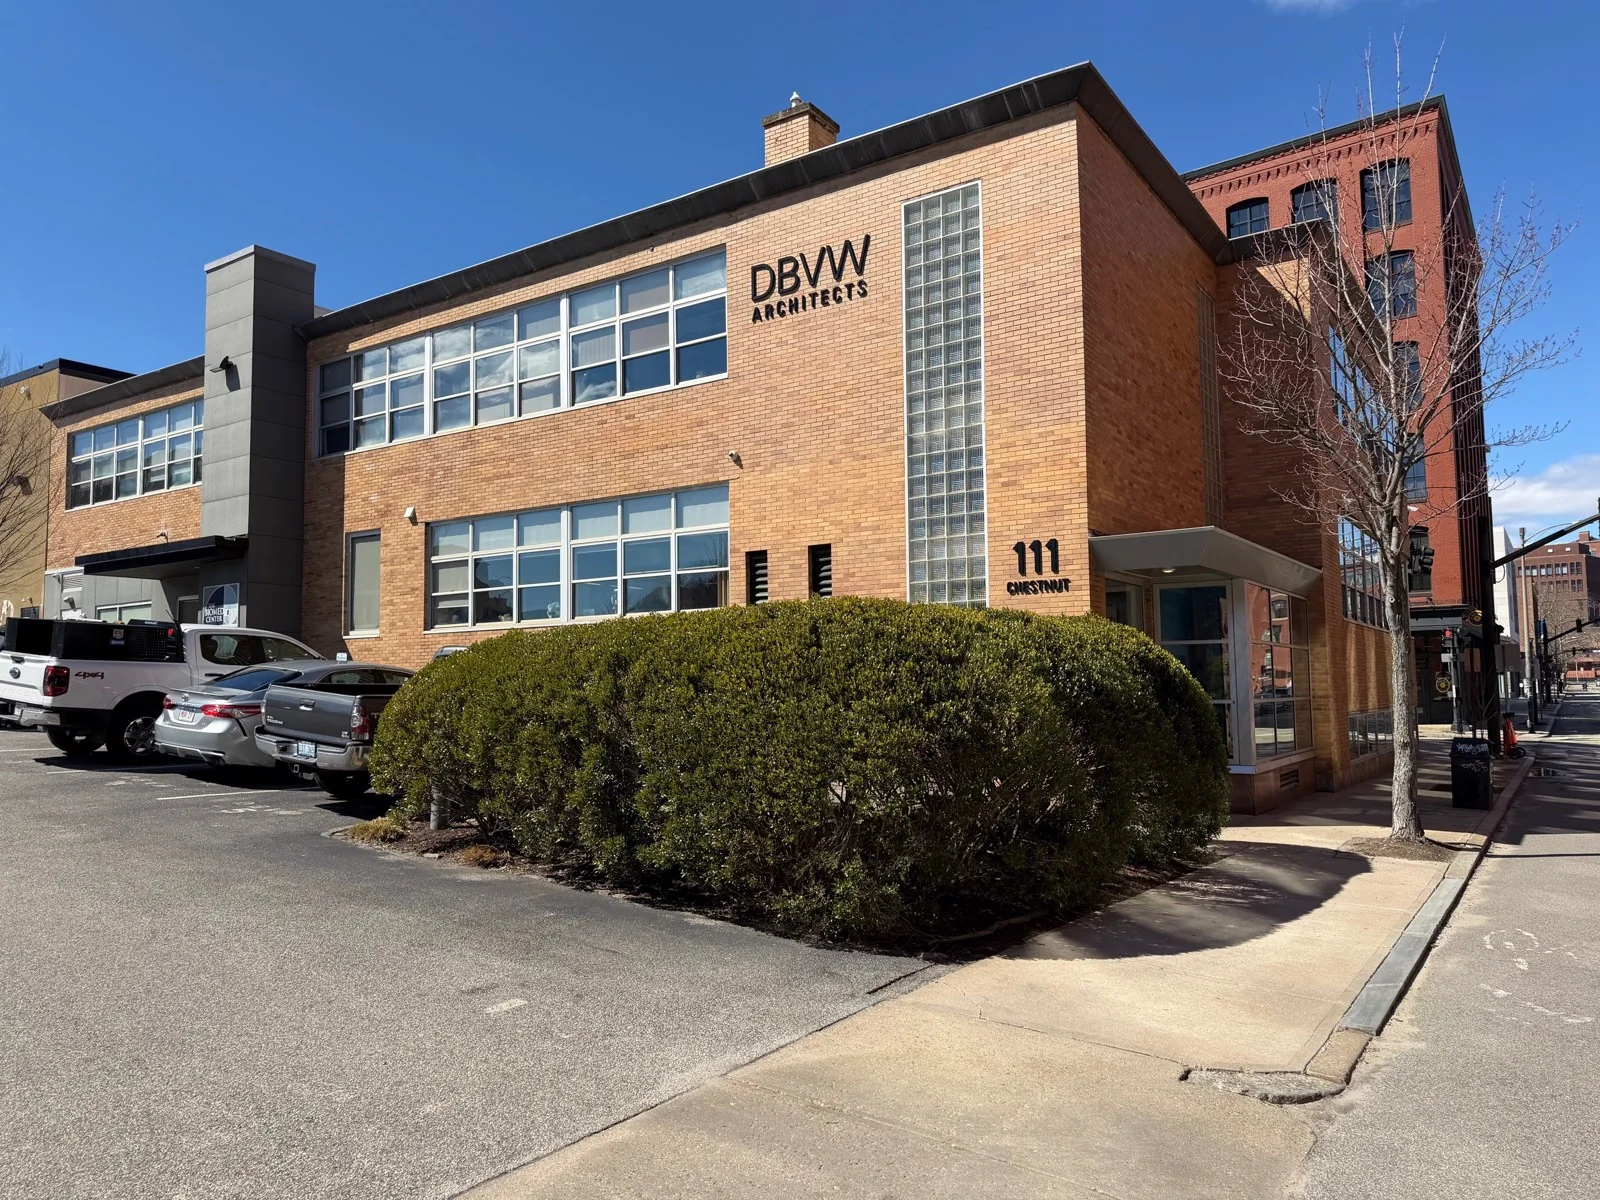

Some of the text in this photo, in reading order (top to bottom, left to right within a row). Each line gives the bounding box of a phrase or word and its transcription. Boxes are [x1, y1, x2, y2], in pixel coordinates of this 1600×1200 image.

[751, 234, 871, 303] DBVW
[752, 279, 868, 324] ARCHITECTS
[1012, 538, 1060, 577] 111
[1007, 578, 1071, 596] CHESTNUT
[74, 671, 104, 680] 4x4
